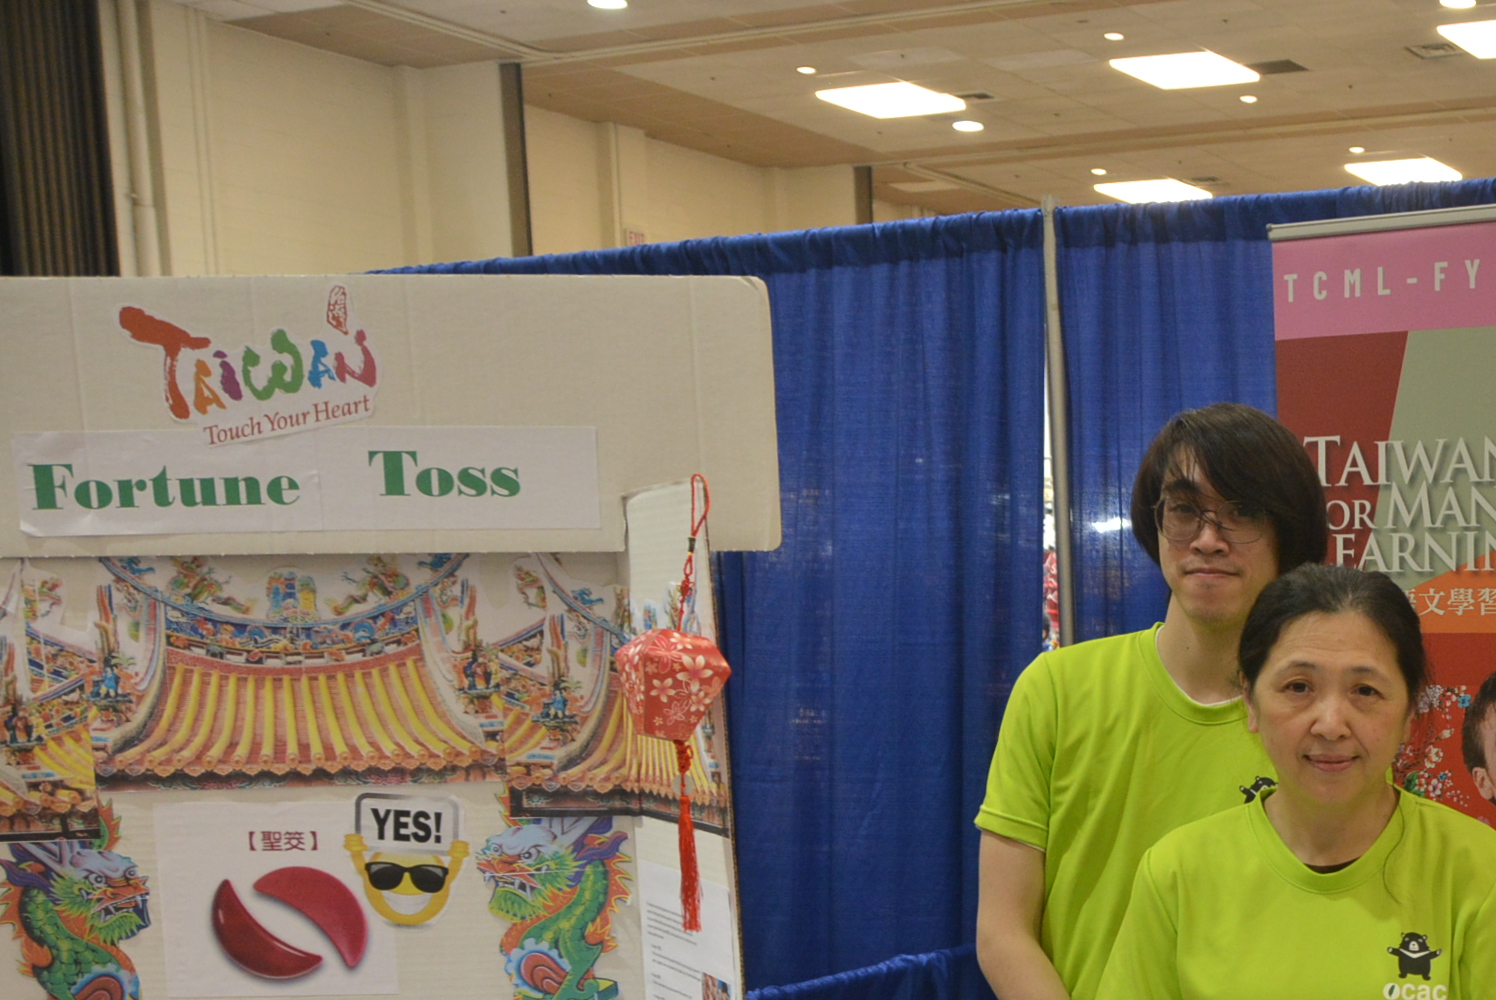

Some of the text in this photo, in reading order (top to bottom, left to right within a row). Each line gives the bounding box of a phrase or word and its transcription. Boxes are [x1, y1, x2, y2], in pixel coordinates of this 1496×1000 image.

[204, 395, 371, 446] Touch Your Heart
[28, 449, 522, 511] Fortune Toss
[1326, 497, 1377, 531] OR
[370, 807, 443, 844] YES!
